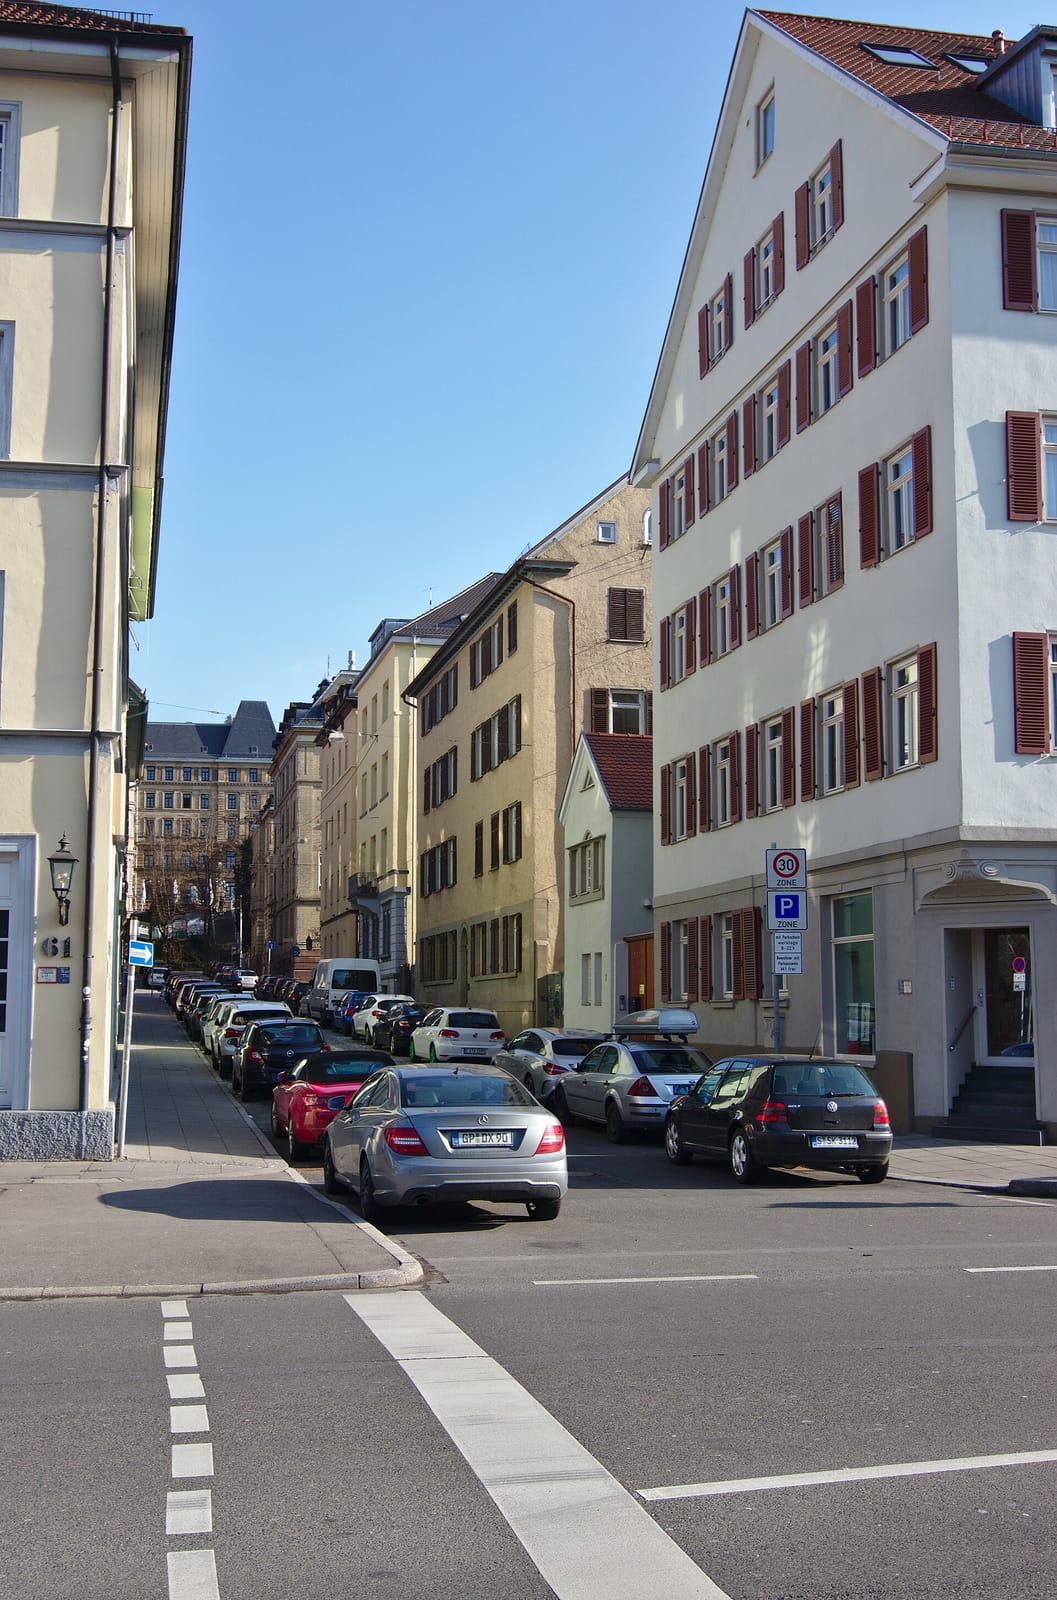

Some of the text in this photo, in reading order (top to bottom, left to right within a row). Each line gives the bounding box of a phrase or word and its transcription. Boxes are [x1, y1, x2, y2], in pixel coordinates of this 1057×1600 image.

[778, 858, 794, 871] 30
[781, 898, 793, 915] P
[777, 920, 798, 928] ZONE
[41, 937, 72, 958] 61
[462, 1132, 508, 1143] GP DX 90
